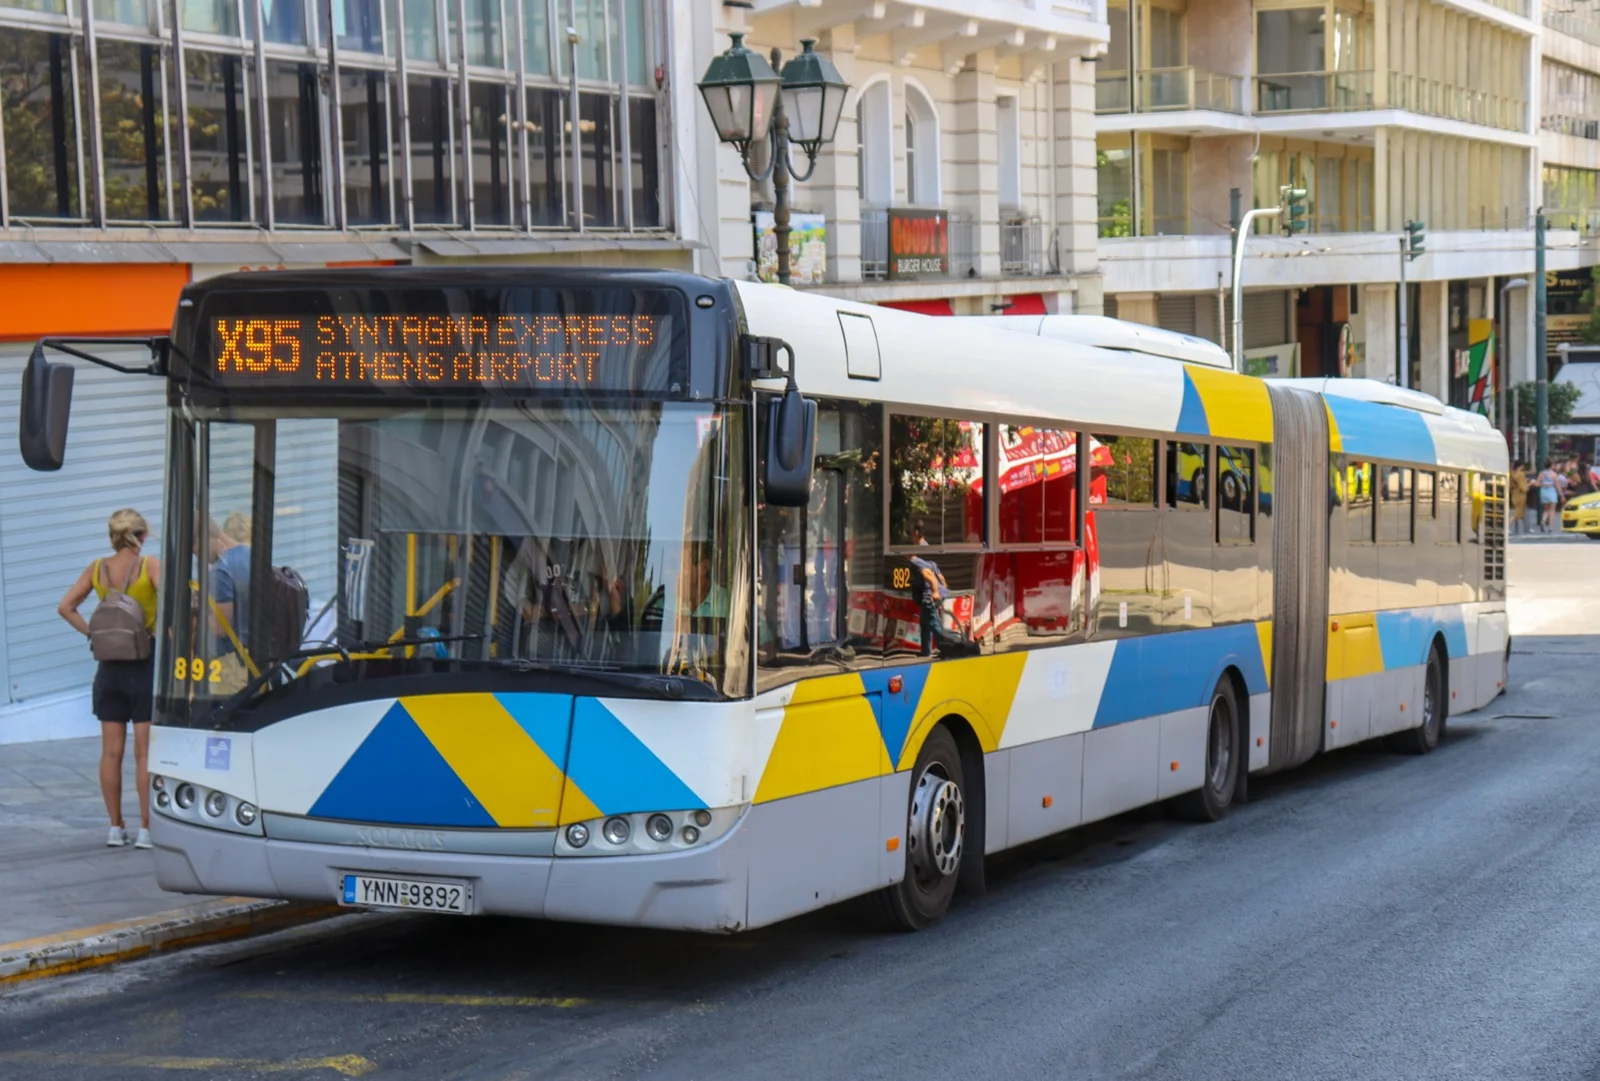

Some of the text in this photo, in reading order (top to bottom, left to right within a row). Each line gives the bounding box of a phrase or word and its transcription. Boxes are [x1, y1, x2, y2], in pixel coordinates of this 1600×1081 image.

[892, 212, 947, 255] GOODY'S
[897, 258, 942, 273] BURGER HOUSE
[316, 316, 654, 345] SYNTAGMA EXPRESS
[217, 319, 300, 372] X95
[316, 351, 600, 381] ATHENS AIRPORT
[893, 567, 911, 589] 892
[174, 656, 222, 683] 892
[358, 826, 445, 851] SOLARIS
